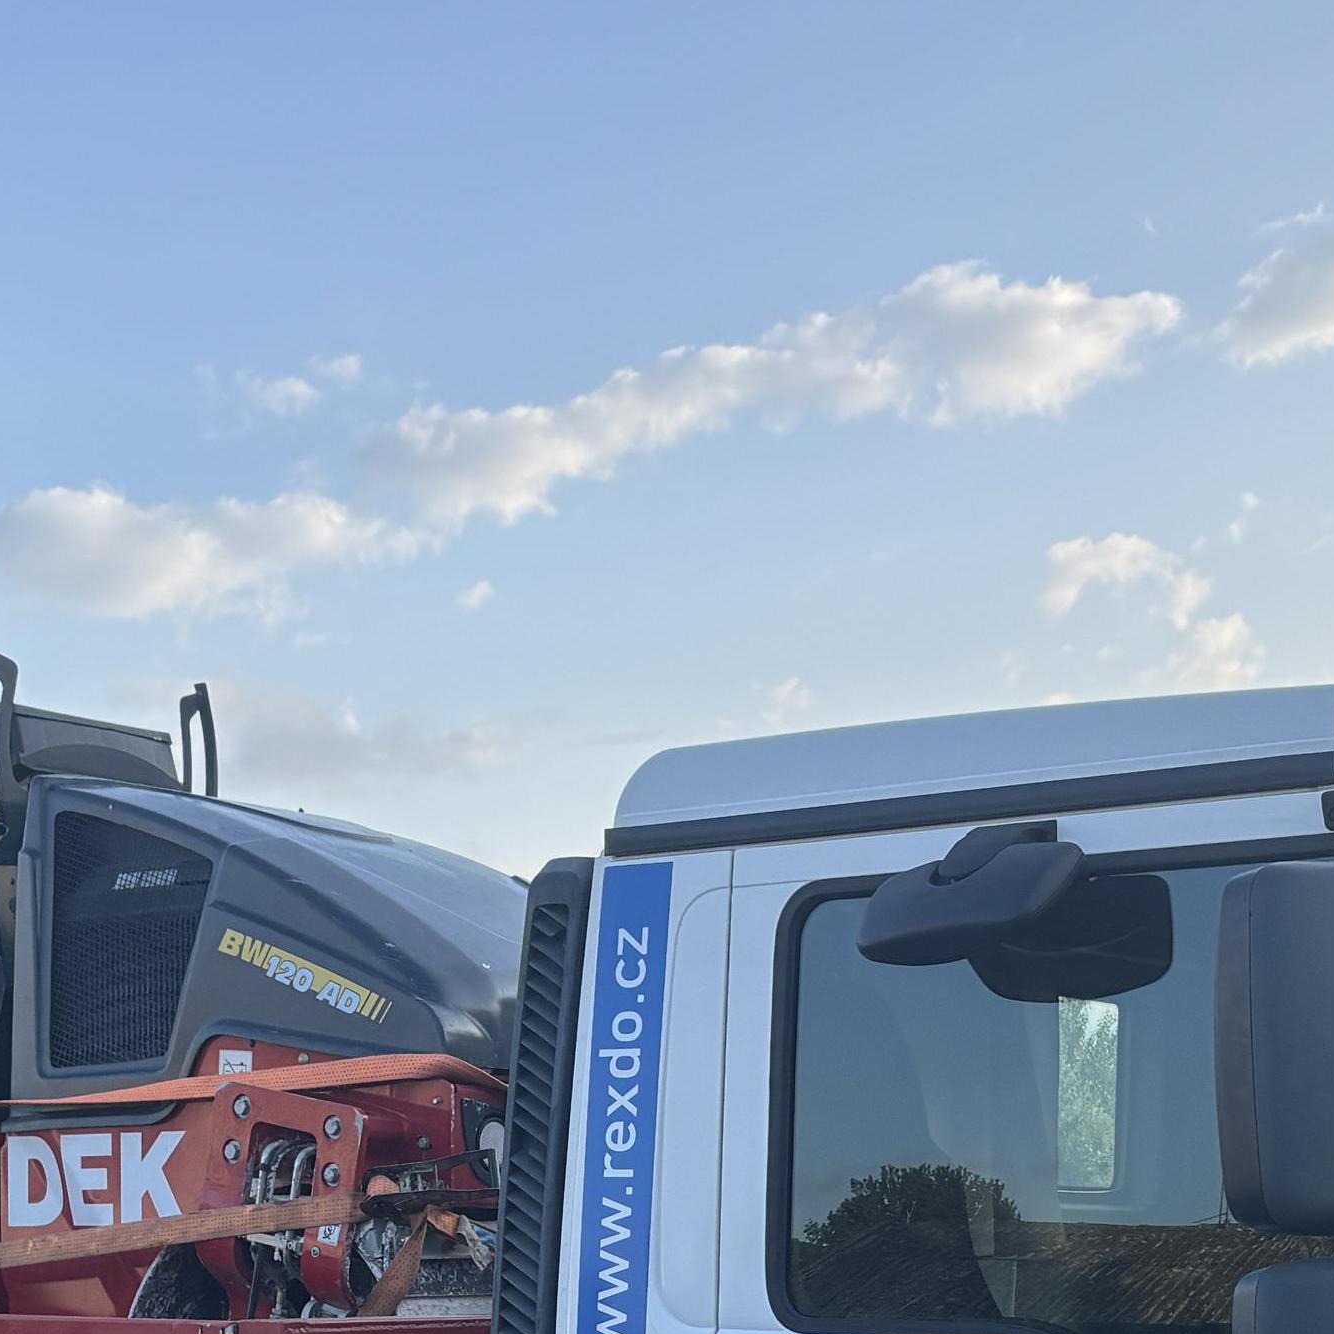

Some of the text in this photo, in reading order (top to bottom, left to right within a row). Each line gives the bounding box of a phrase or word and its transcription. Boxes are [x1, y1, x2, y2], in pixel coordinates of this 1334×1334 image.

[218, 928, 361, 1015] BW 120 AD
[8, 1131, 187, 1227] DEK
